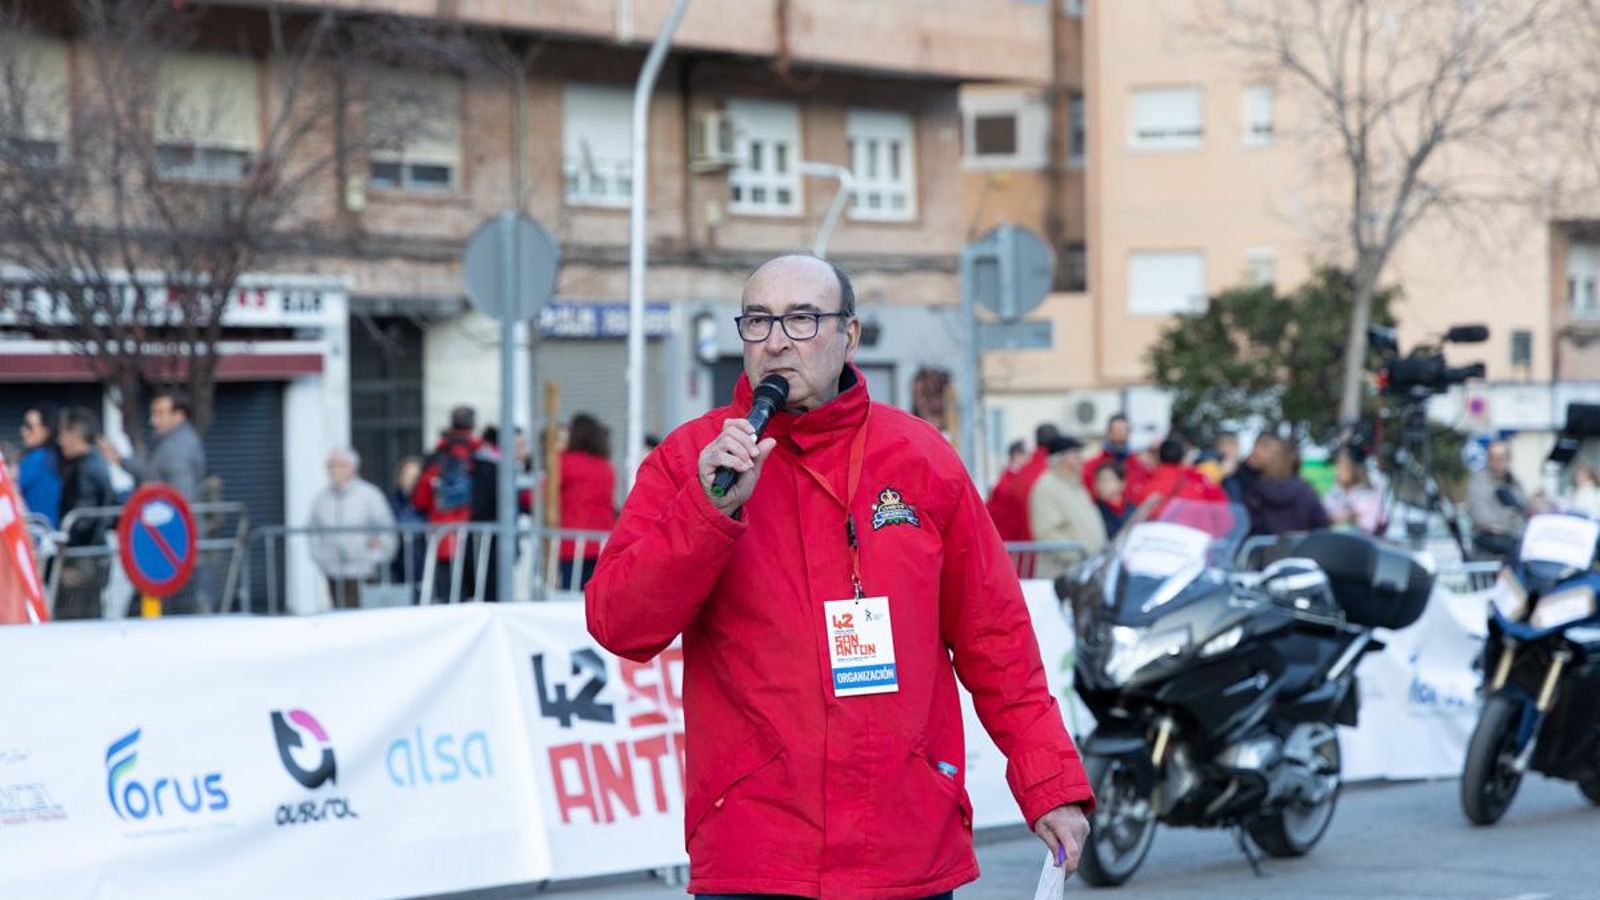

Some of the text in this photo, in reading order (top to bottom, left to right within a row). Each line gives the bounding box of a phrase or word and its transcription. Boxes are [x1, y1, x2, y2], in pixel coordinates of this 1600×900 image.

[833, 613, 854, 629] 42
[835, 634, 859, 648] SAN
[532, 648, 615, 728] 42
[836, 666, 894, 684] ORGANIZACIÓN
[387, 725, 494, 786] alsa
[548, 734, 686, 824] ANT
